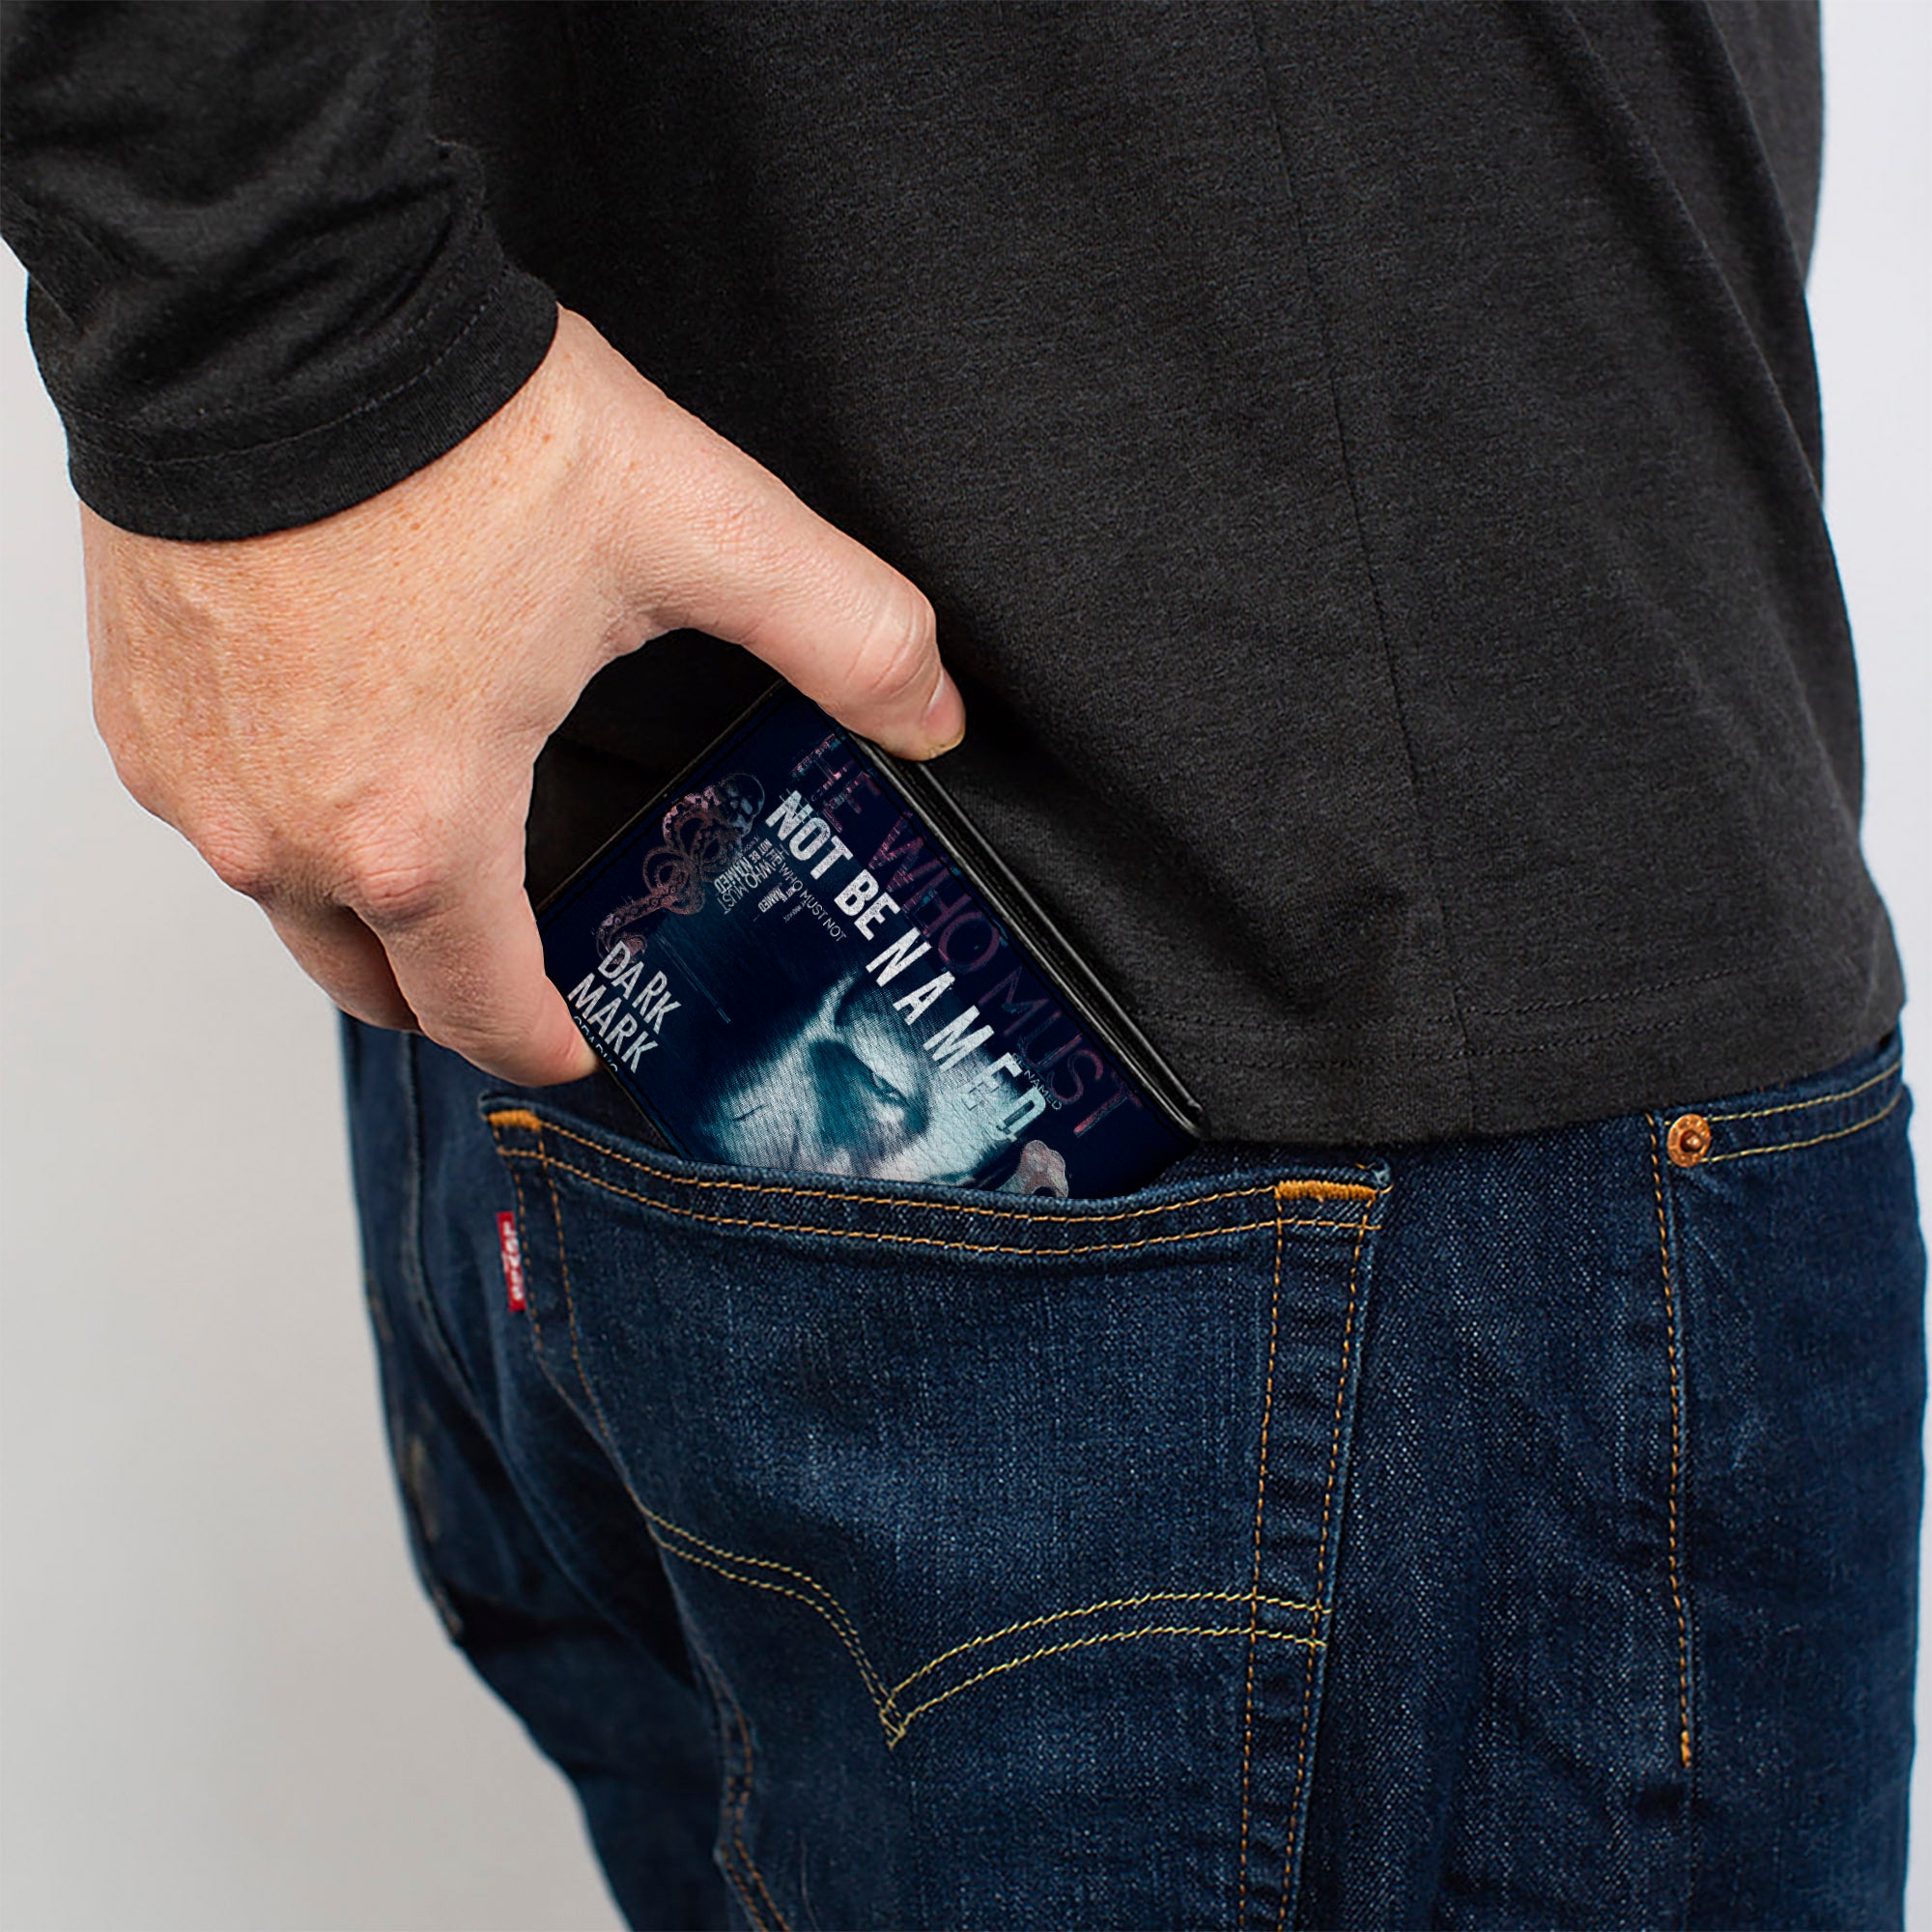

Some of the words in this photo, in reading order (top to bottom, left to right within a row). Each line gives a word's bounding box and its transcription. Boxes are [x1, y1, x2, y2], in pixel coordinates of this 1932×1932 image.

[749, 850, 761, 864] BE
[757, 838, 773, 856] NOT
[765, 789, 854, 880] NOT
[714, 856, 754, 895] NAMED
[717, 876, 750, 915] MUST
[745, 859, 777, 889] WHO
[779, 862, 804, 892] WHO
[799, 889, 829, 921] MUST
[822, 917, 847, 942] NOT
[834, 868, 900, 941] BE
[597, 940, 682, 1036] DARK
[868, 810, 1002, 975] WHO
[978, 966, 1143, 1137] MUST
[567, 972, 659, 1074] MARK
[866, 926, 1047, 1143] NAMED
[1024, 1069, 1063, 1110] NAMED
